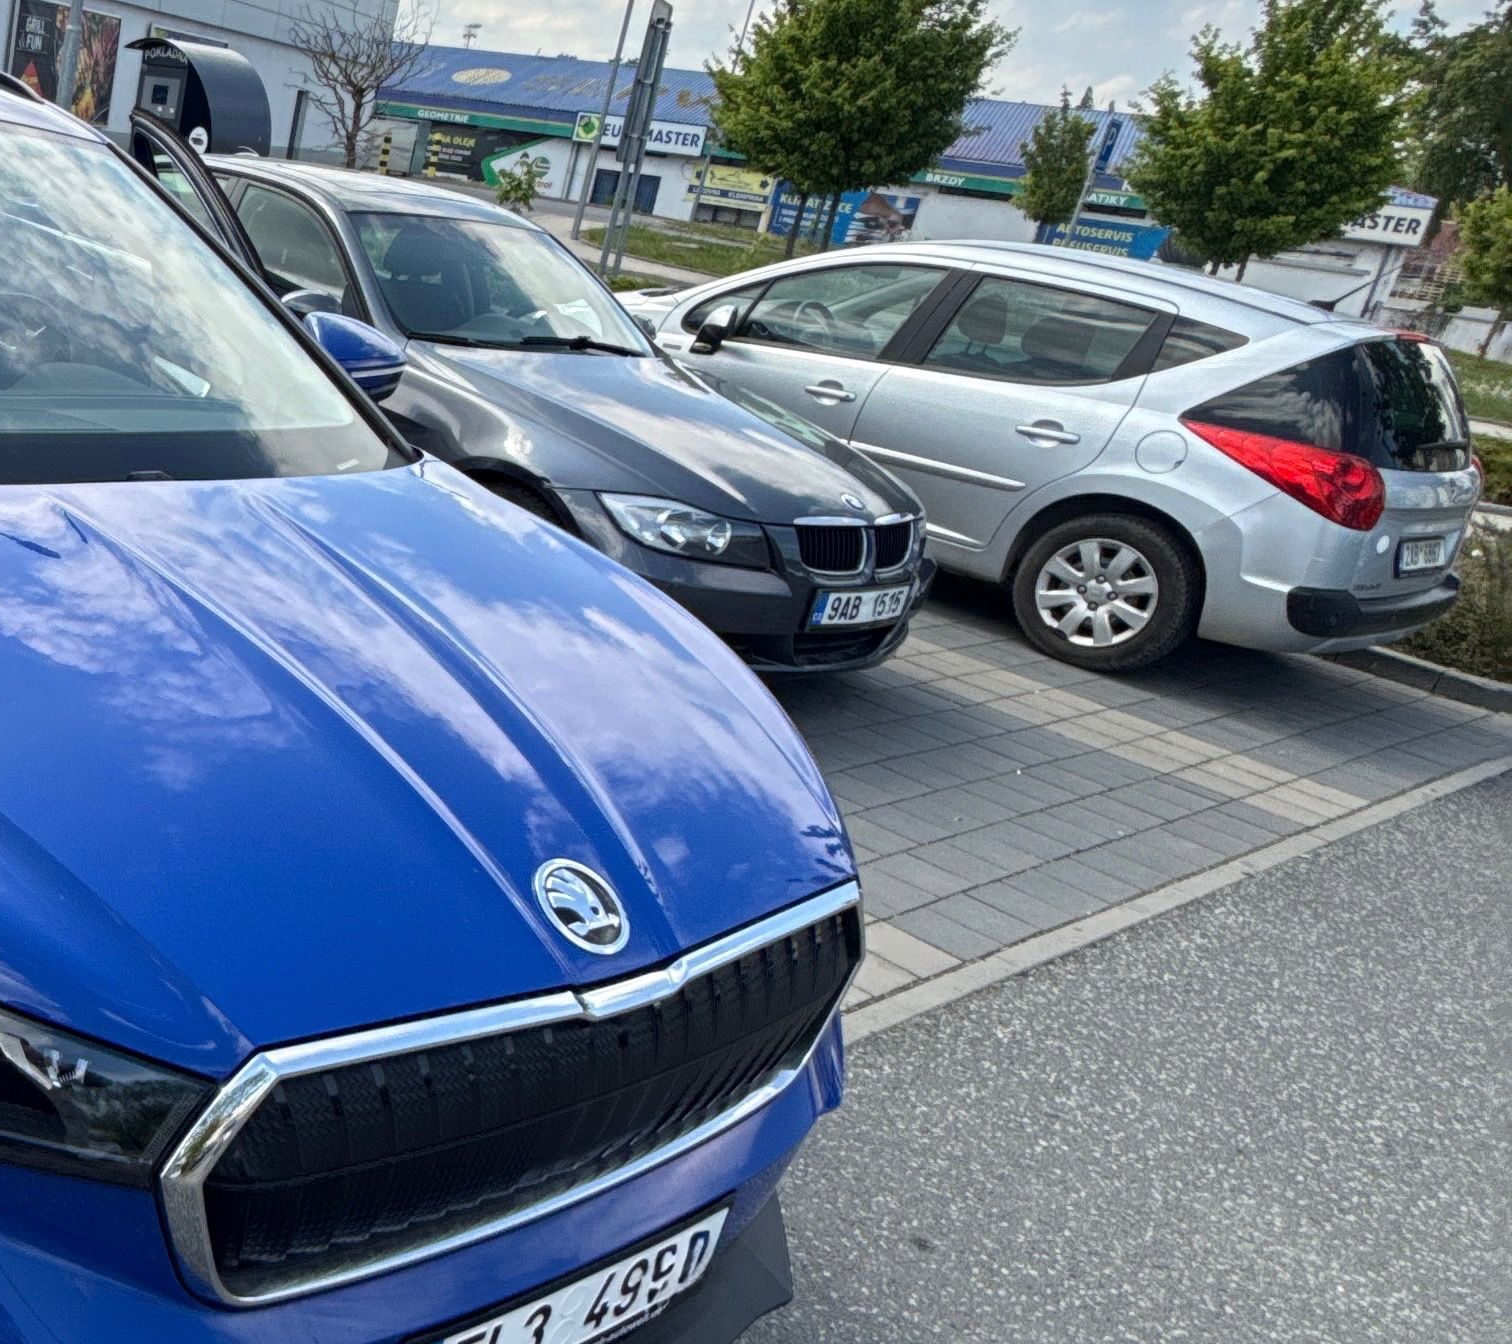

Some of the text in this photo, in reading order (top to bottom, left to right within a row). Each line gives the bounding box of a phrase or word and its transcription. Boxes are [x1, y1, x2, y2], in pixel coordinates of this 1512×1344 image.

[417, 109, 470, 123] GEOMETRIE
[603, 123, 701, 148] EUASTER
[925, 173, 966, 187] BRZDY
[779, 193, 854, 214] KLIATZCE
[1087, 191, 1128, 206] ATIKY
[1350, 215, 1422, 235] ASTER
[827, 595, 862, 621] 9AB
